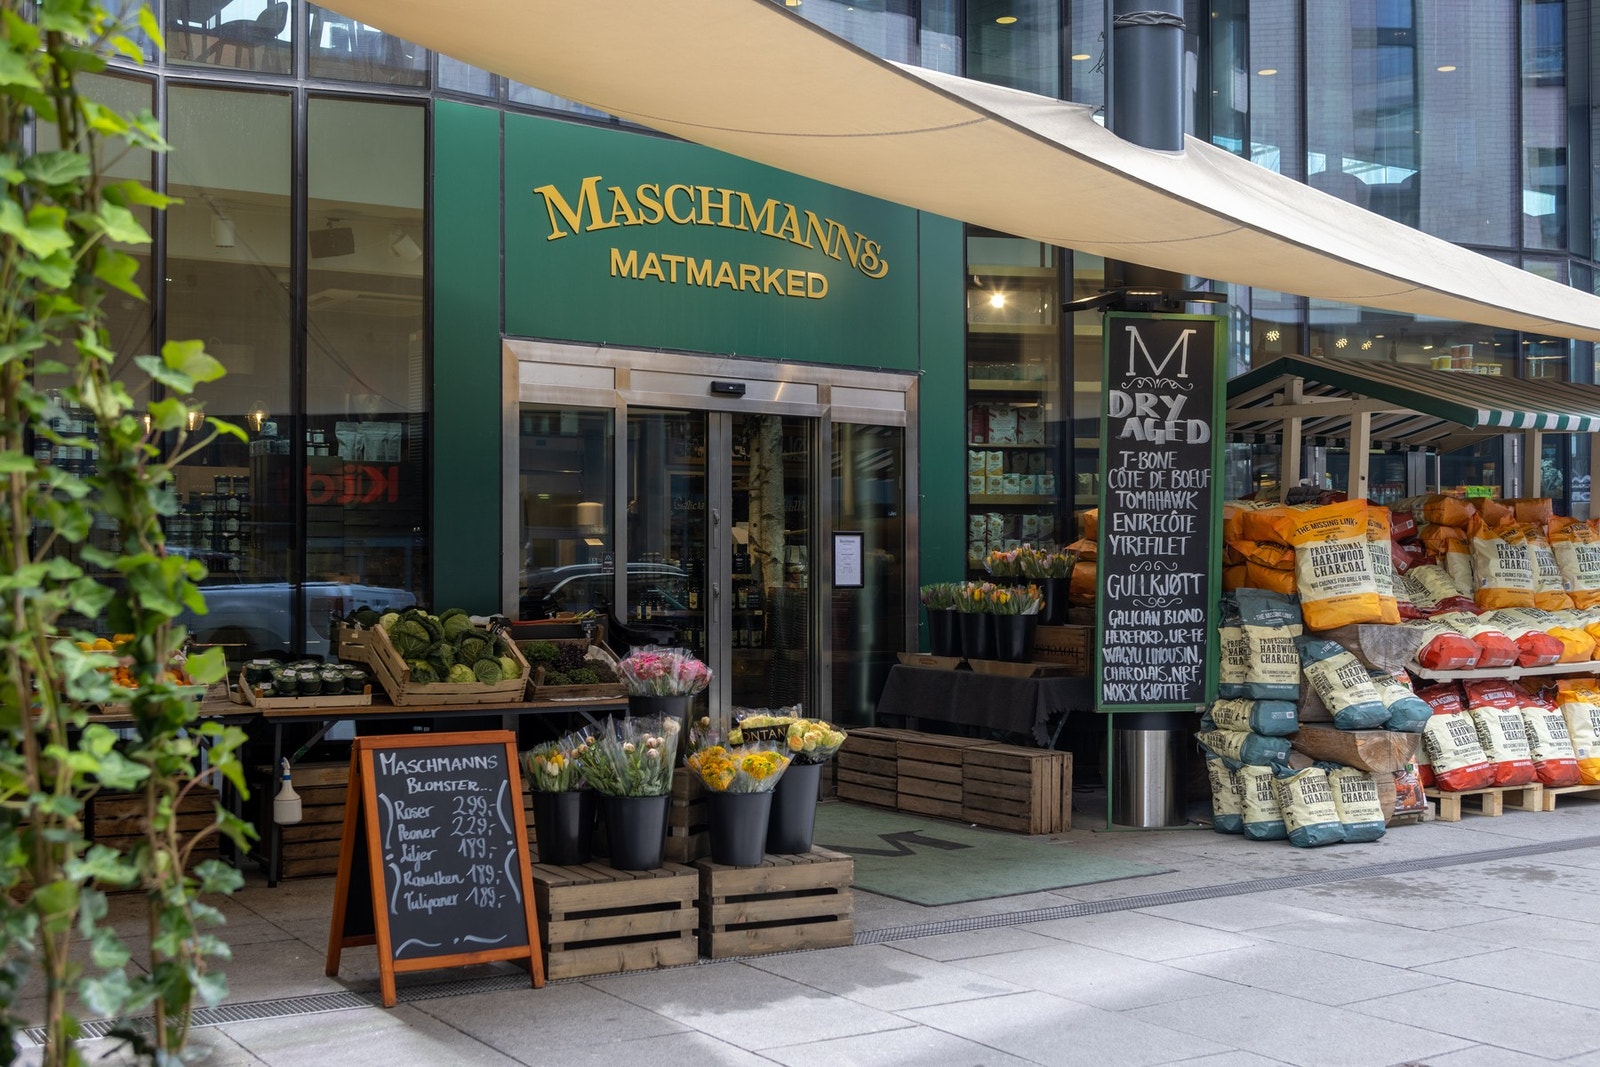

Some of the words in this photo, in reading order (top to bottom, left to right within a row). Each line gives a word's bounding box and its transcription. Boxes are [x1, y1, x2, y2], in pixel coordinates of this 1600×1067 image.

[533, 175, 889, 280] MASCHMANNS
[609, 247, 829, 300] MATMARKED
[1125, 325, 1197, 378] M
[1107, 389, 1188, 421] DRY
[1115, 416, 1211, 445] AGED
[1119, 450, 1178, 470] T-BONE
[1108, 467, 1145, 489] CÔTE
[1149, 470, 1168, 489] DE
[1171, 468, 1212, 489] BOEUF
[1115, 490, 1199, 511] TOMAHAWK
[1113, 510, 1197, 535] ENTRECÔTE
[1296, 524, 1310, 536] THE
[1311, 518, 1339, 530] MISSING
[1340, 517, 1356, 527] LINK
[1108, 534, 1192, 557] YTREFILET
[1309, 541, 1364, 557] PROFESSIONAL
[1311, 549, 1365, 567] HARDWOOD
[1500, 559, 1532, 571] CHARC
[1314, 560, 1367, 578] CHARCOAL
[1107, 572, 1205, 600] GULLKJØTT
[1108, 609, 1161, 629] GALICIAN
[1260, 653, 1298, 665] CHARCOAL
[1337, 664, 1367, 681] HARDW
[1342, 673, 1371, 690] CHARC
[1103, 683, 1139, 702] NORSK
[379, 752, 498, 776] MASCHMANNS
[394, 800, 435, 820] Roser
[397, 823, 441, 842] Peoner
[400, 843, 438, 872] Liljer
